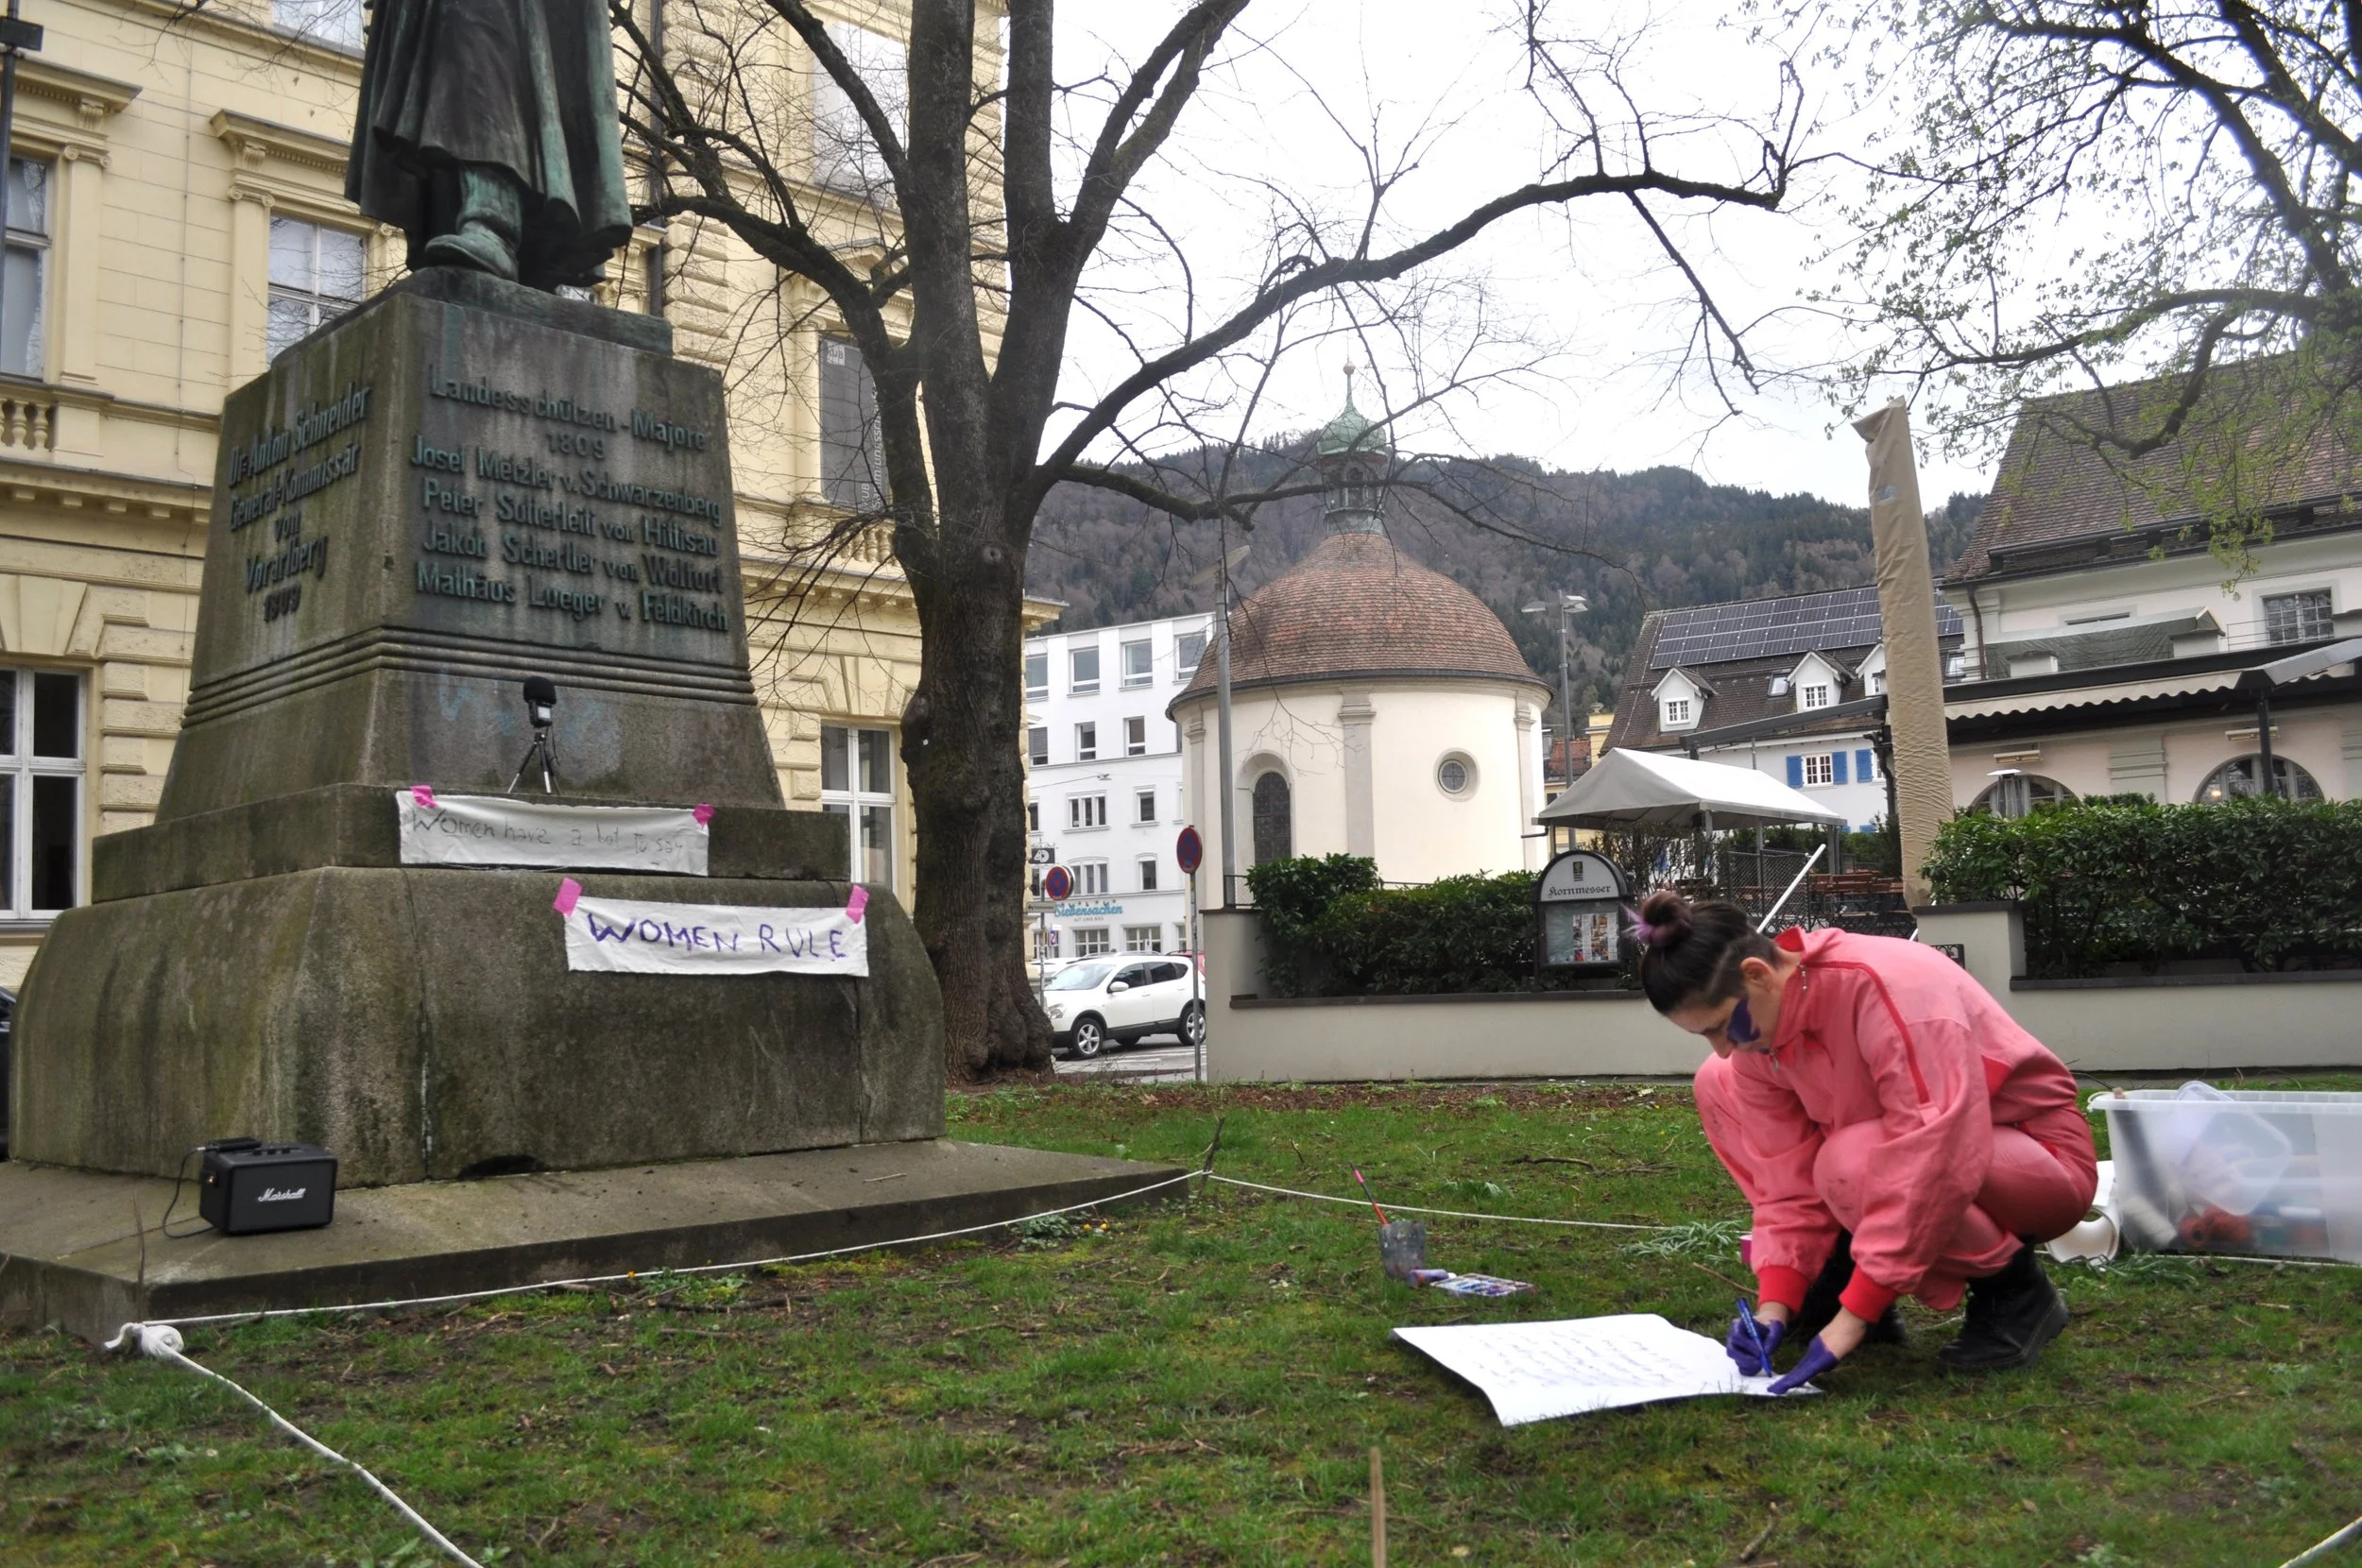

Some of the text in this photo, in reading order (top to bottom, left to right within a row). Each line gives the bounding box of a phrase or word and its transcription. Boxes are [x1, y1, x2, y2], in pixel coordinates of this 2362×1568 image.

[293, 383, 371, 454] Schneider
[546, 428, 607, 460] 1809
[411, 434, 467, 473] Josef
[477, 446, 555, 490] Metzler
[581, 469, 723, 528] Schwarzenberg
[274, 512, 301, 544] von
[423, 477, 484, 518] Peter
[601, 521, 634, 542] von
[642, 516, 718, 556] Hittisau
[246, 537, 328, 595] Vorarlberg
[423, 519, 488, 559] Jakob
[603, 560, 639, 582] von
[416, 559, 516, 605] Mathäus
[642, 589, 728, 632] Feldkirch
[412, 809, 496, 839] Women
[504, 816, 552, 844] have
[571, 828, 583, 847] a
[1053, 903, 1123, 917] Siebensachen
[1548, 884, 1612, 899] Kornmesser
[587, 912, 848, 961] WOMEN RULE
[257, 1187, 307, 1202] Marshall
